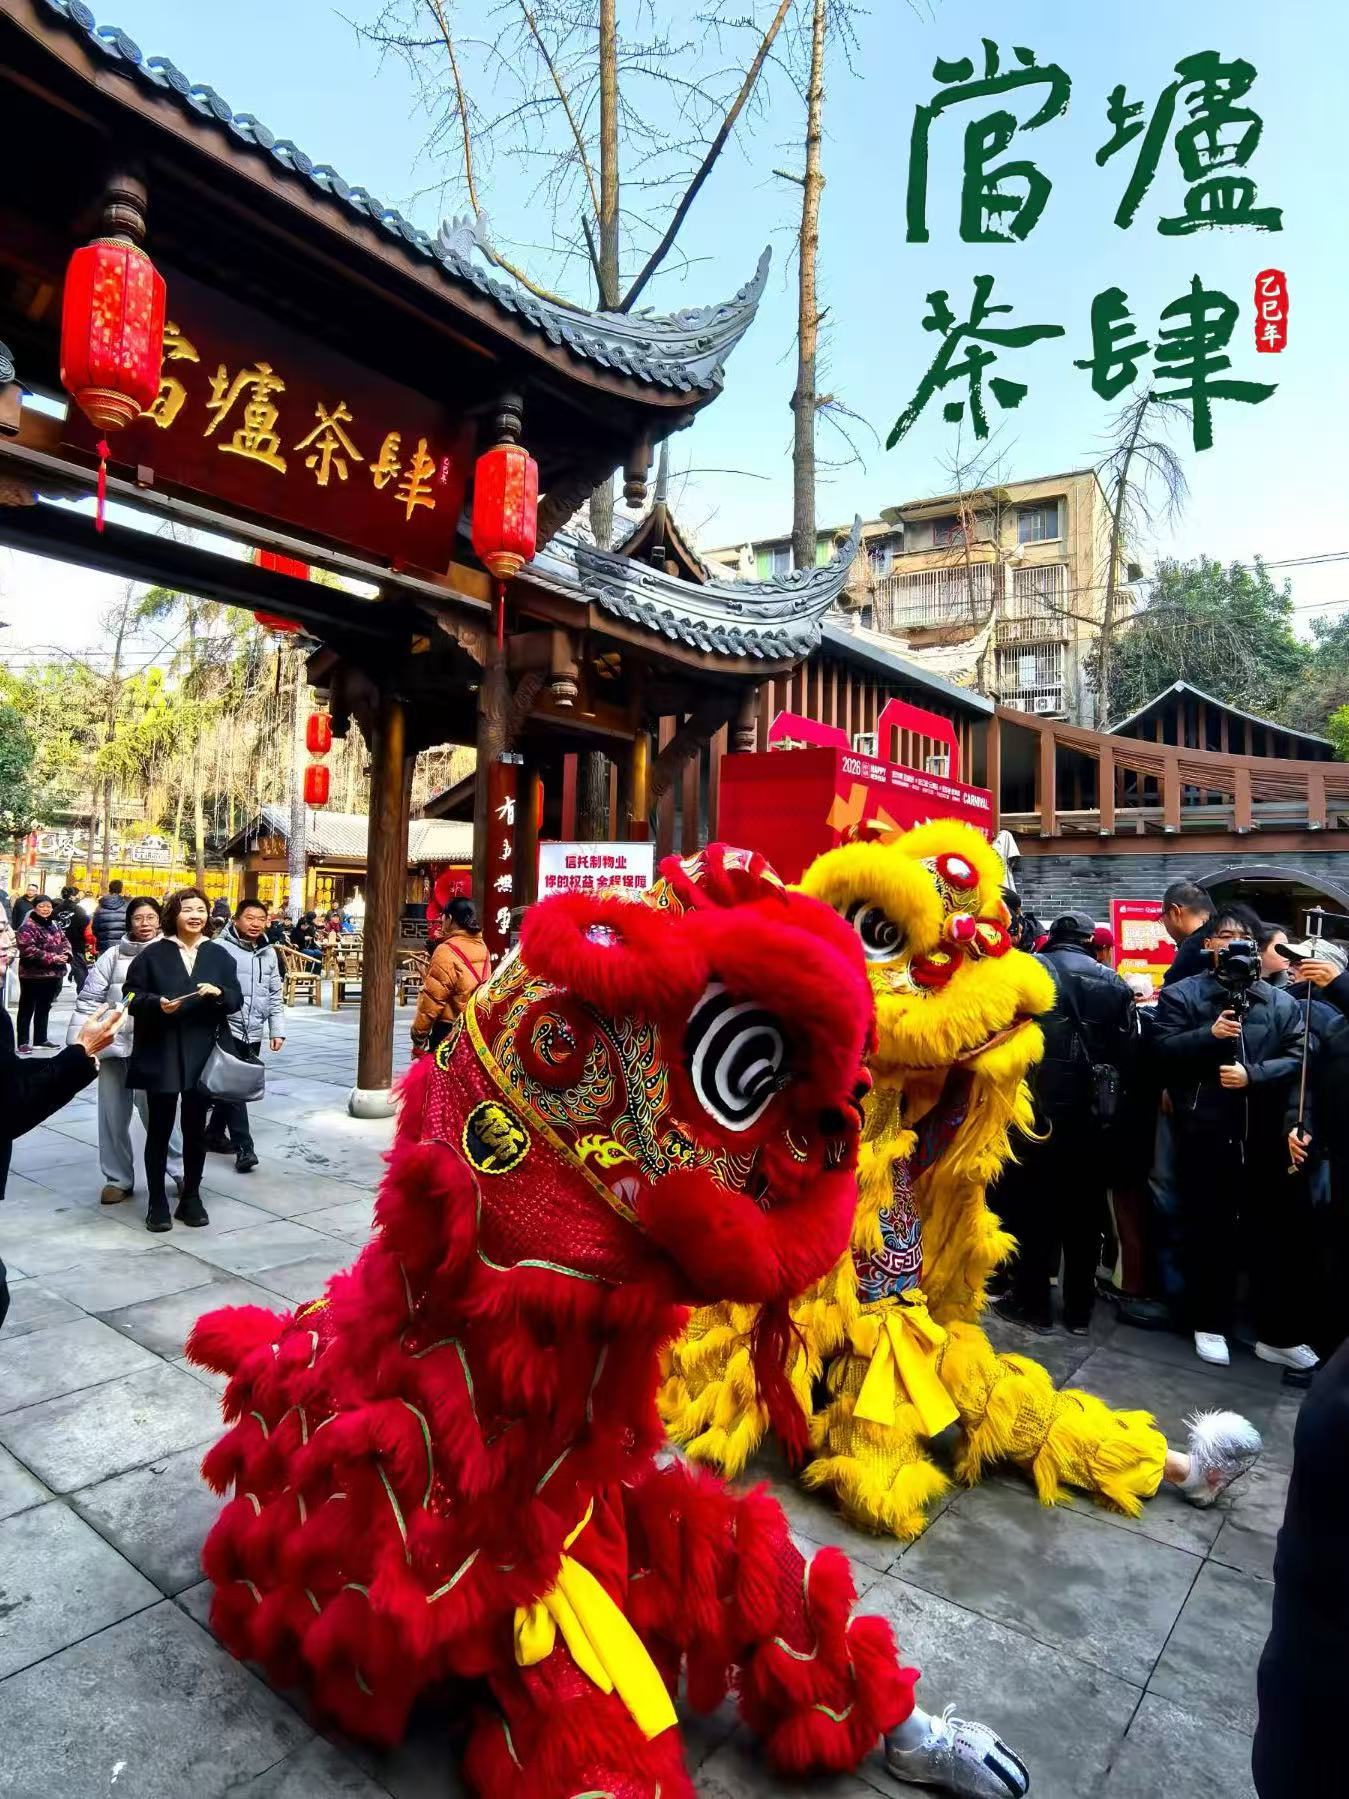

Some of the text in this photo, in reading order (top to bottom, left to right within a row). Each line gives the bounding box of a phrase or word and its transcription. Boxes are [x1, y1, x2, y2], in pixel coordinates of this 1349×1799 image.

[842, 756, 861, 775] 2026
[565, 855, 627, 869] 信托制物业
[545, 875, 594, 888] 你的权益
